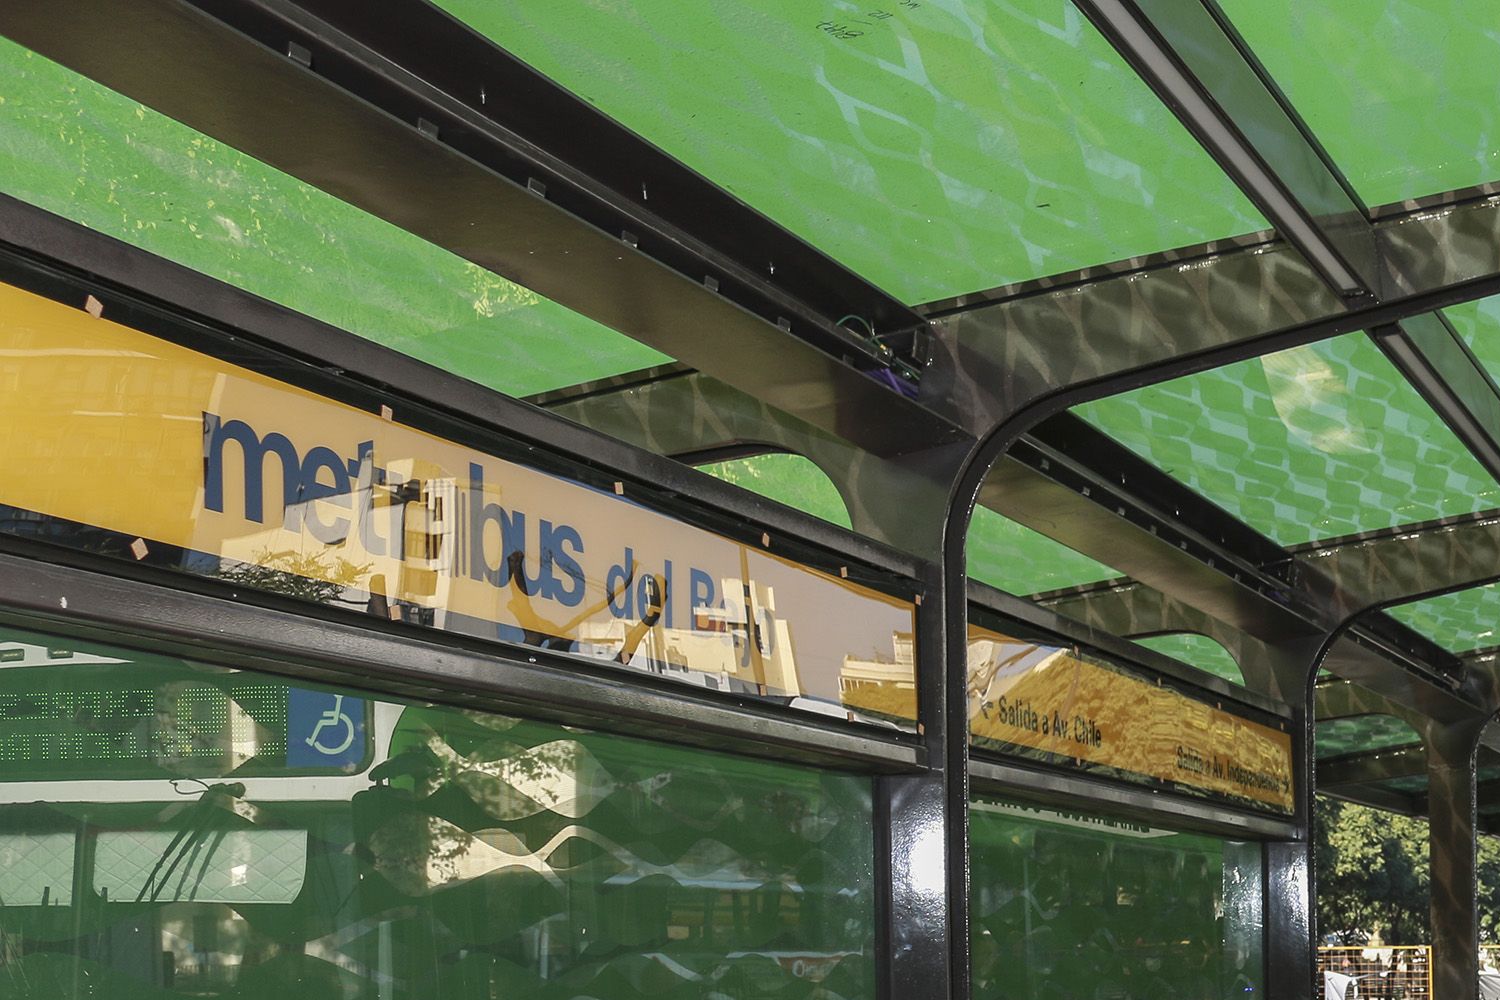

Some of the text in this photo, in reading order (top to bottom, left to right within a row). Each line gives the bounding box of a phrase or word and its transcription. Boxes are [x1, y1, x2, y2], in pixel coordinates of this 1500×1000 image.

[203, 410, 588, 608] metrbus
[606, 546, 673, 630] del
[998, 695, 1103, 748] Salida a Av. Chile
[1176, 744, 1203, 775] Salida
